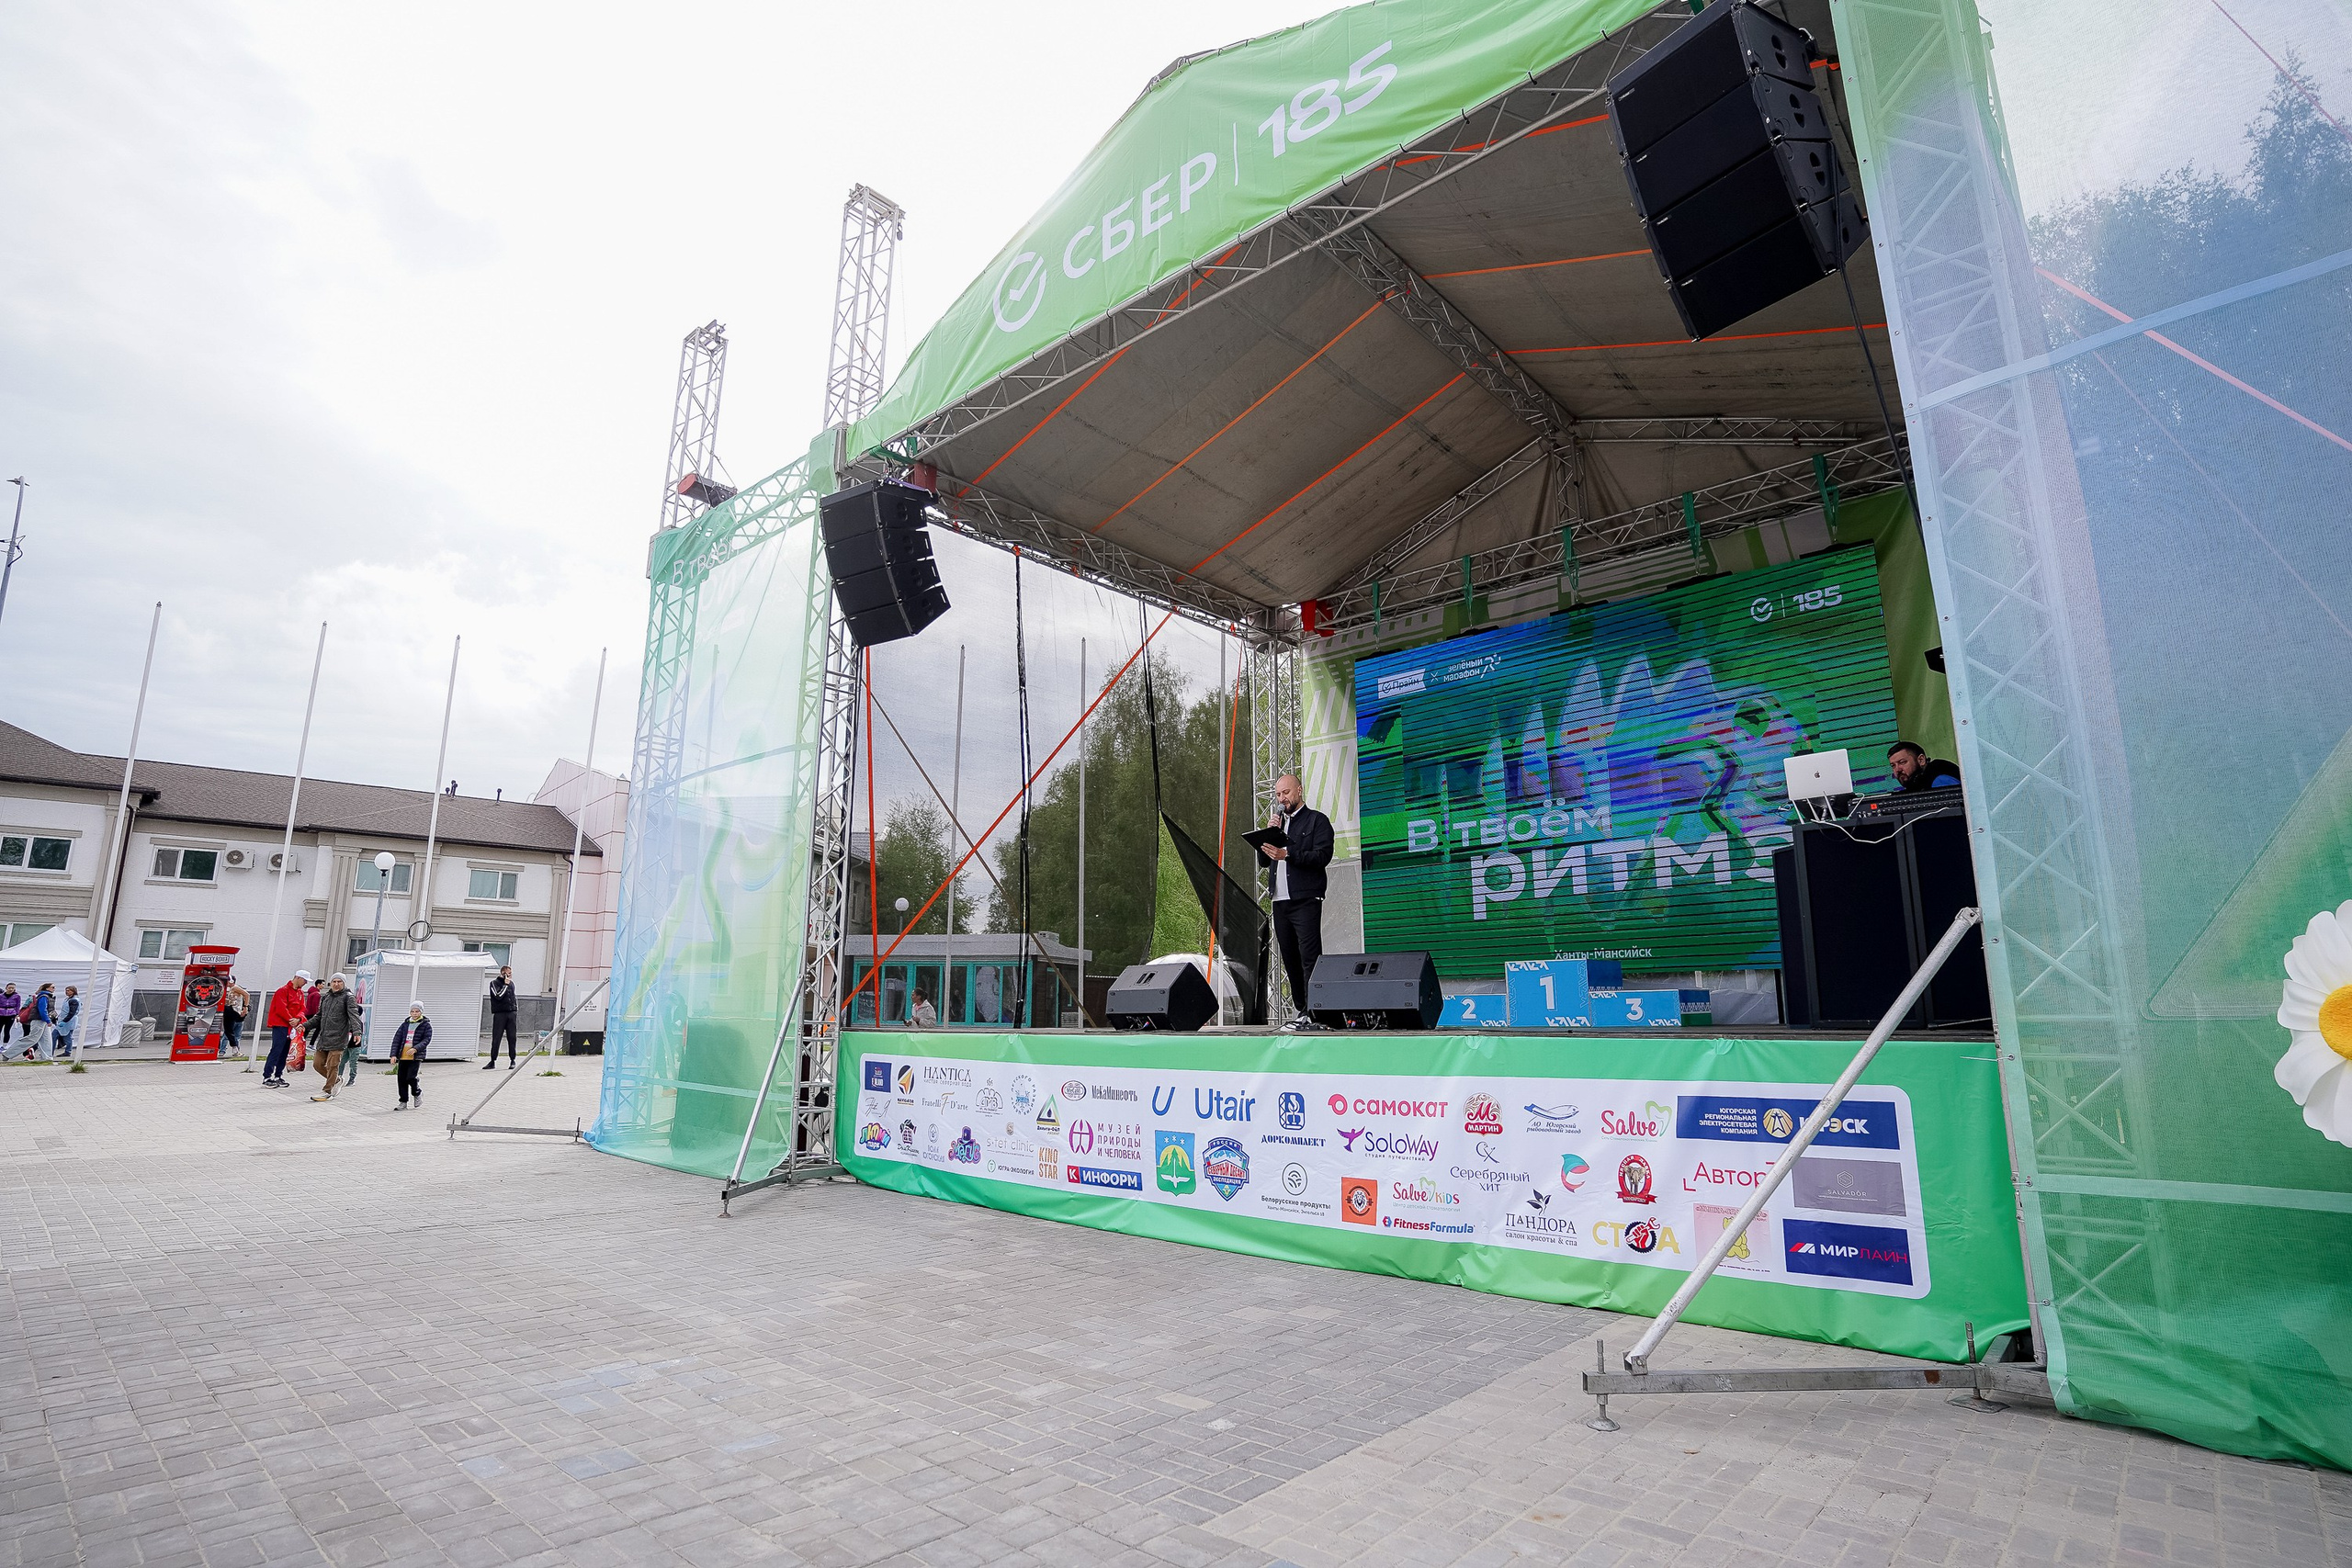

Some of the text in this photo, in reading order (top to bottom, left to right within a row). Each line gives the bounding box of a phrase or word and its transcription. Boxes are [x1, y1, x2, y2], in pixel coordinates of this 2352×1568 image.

[1062, 39, 1398, 279] СБЕР 185
[1792, 584, 1843, 612] 185
[1448, 656, 1483, 672] зелёный
[1443, 668, 1480, 682] марафон
[1393, 677, 1420, 691] Прайм
[1554, 945, 1653, 962] Ханты-Мансийск
[1540, 975, 1555, 1010] 1
[1460, 998, 1477, 1020] 2
[1625, 998, 1644, 1021] 3
[923, 1066, 971, 1082] HANTICA
[1194, 1088, 1256, 1122] Utair
[1352, 1098, 1449, 1118] самокат
[1719, 1107, 1757, 1115] ЮГОРСКАЯ
[1600, 1110, 1659, 1137] Salve
[1699, 1120, 1758, 1128] ЭЛЕКТРОСЕТЕВАЯ
[1704, 1113, 1757, 1122] РЕГИОНАЛЬНАЯ
[1097, 1122, 1141, 1135] МУЗЕЙ
[1467, 1124, 1499, 1133] МАРТИН
[1721, 1127, 1758, 1135] КОМПАНИЯ
[1011, 1139, 1035, 1153] clinic
[1097, 1134, 1141, 1147] ПРИРОДЫ
[1261, 1134, 1326, 1147] ДОРКОМПЛЕКТ
[1038, 1146, 1058, 1164] KINO
[1097, 1147, 1141, 1160] И ЧЕЛОВЕКА
[1038, 1163, 1058, 1180] STAR
[1082, 1169, 1138, 1188] ИНФОРМ
[1450, 1166, 1531, 1183] Серебряный
[1393, 1181, 1429, 1202] Salve
[1261, 1195, 1331, 1209] Белорусские продукты
[1505, 1232, 1525, 1240] салон
[1526, 1234, 1555, 1244] красоты
